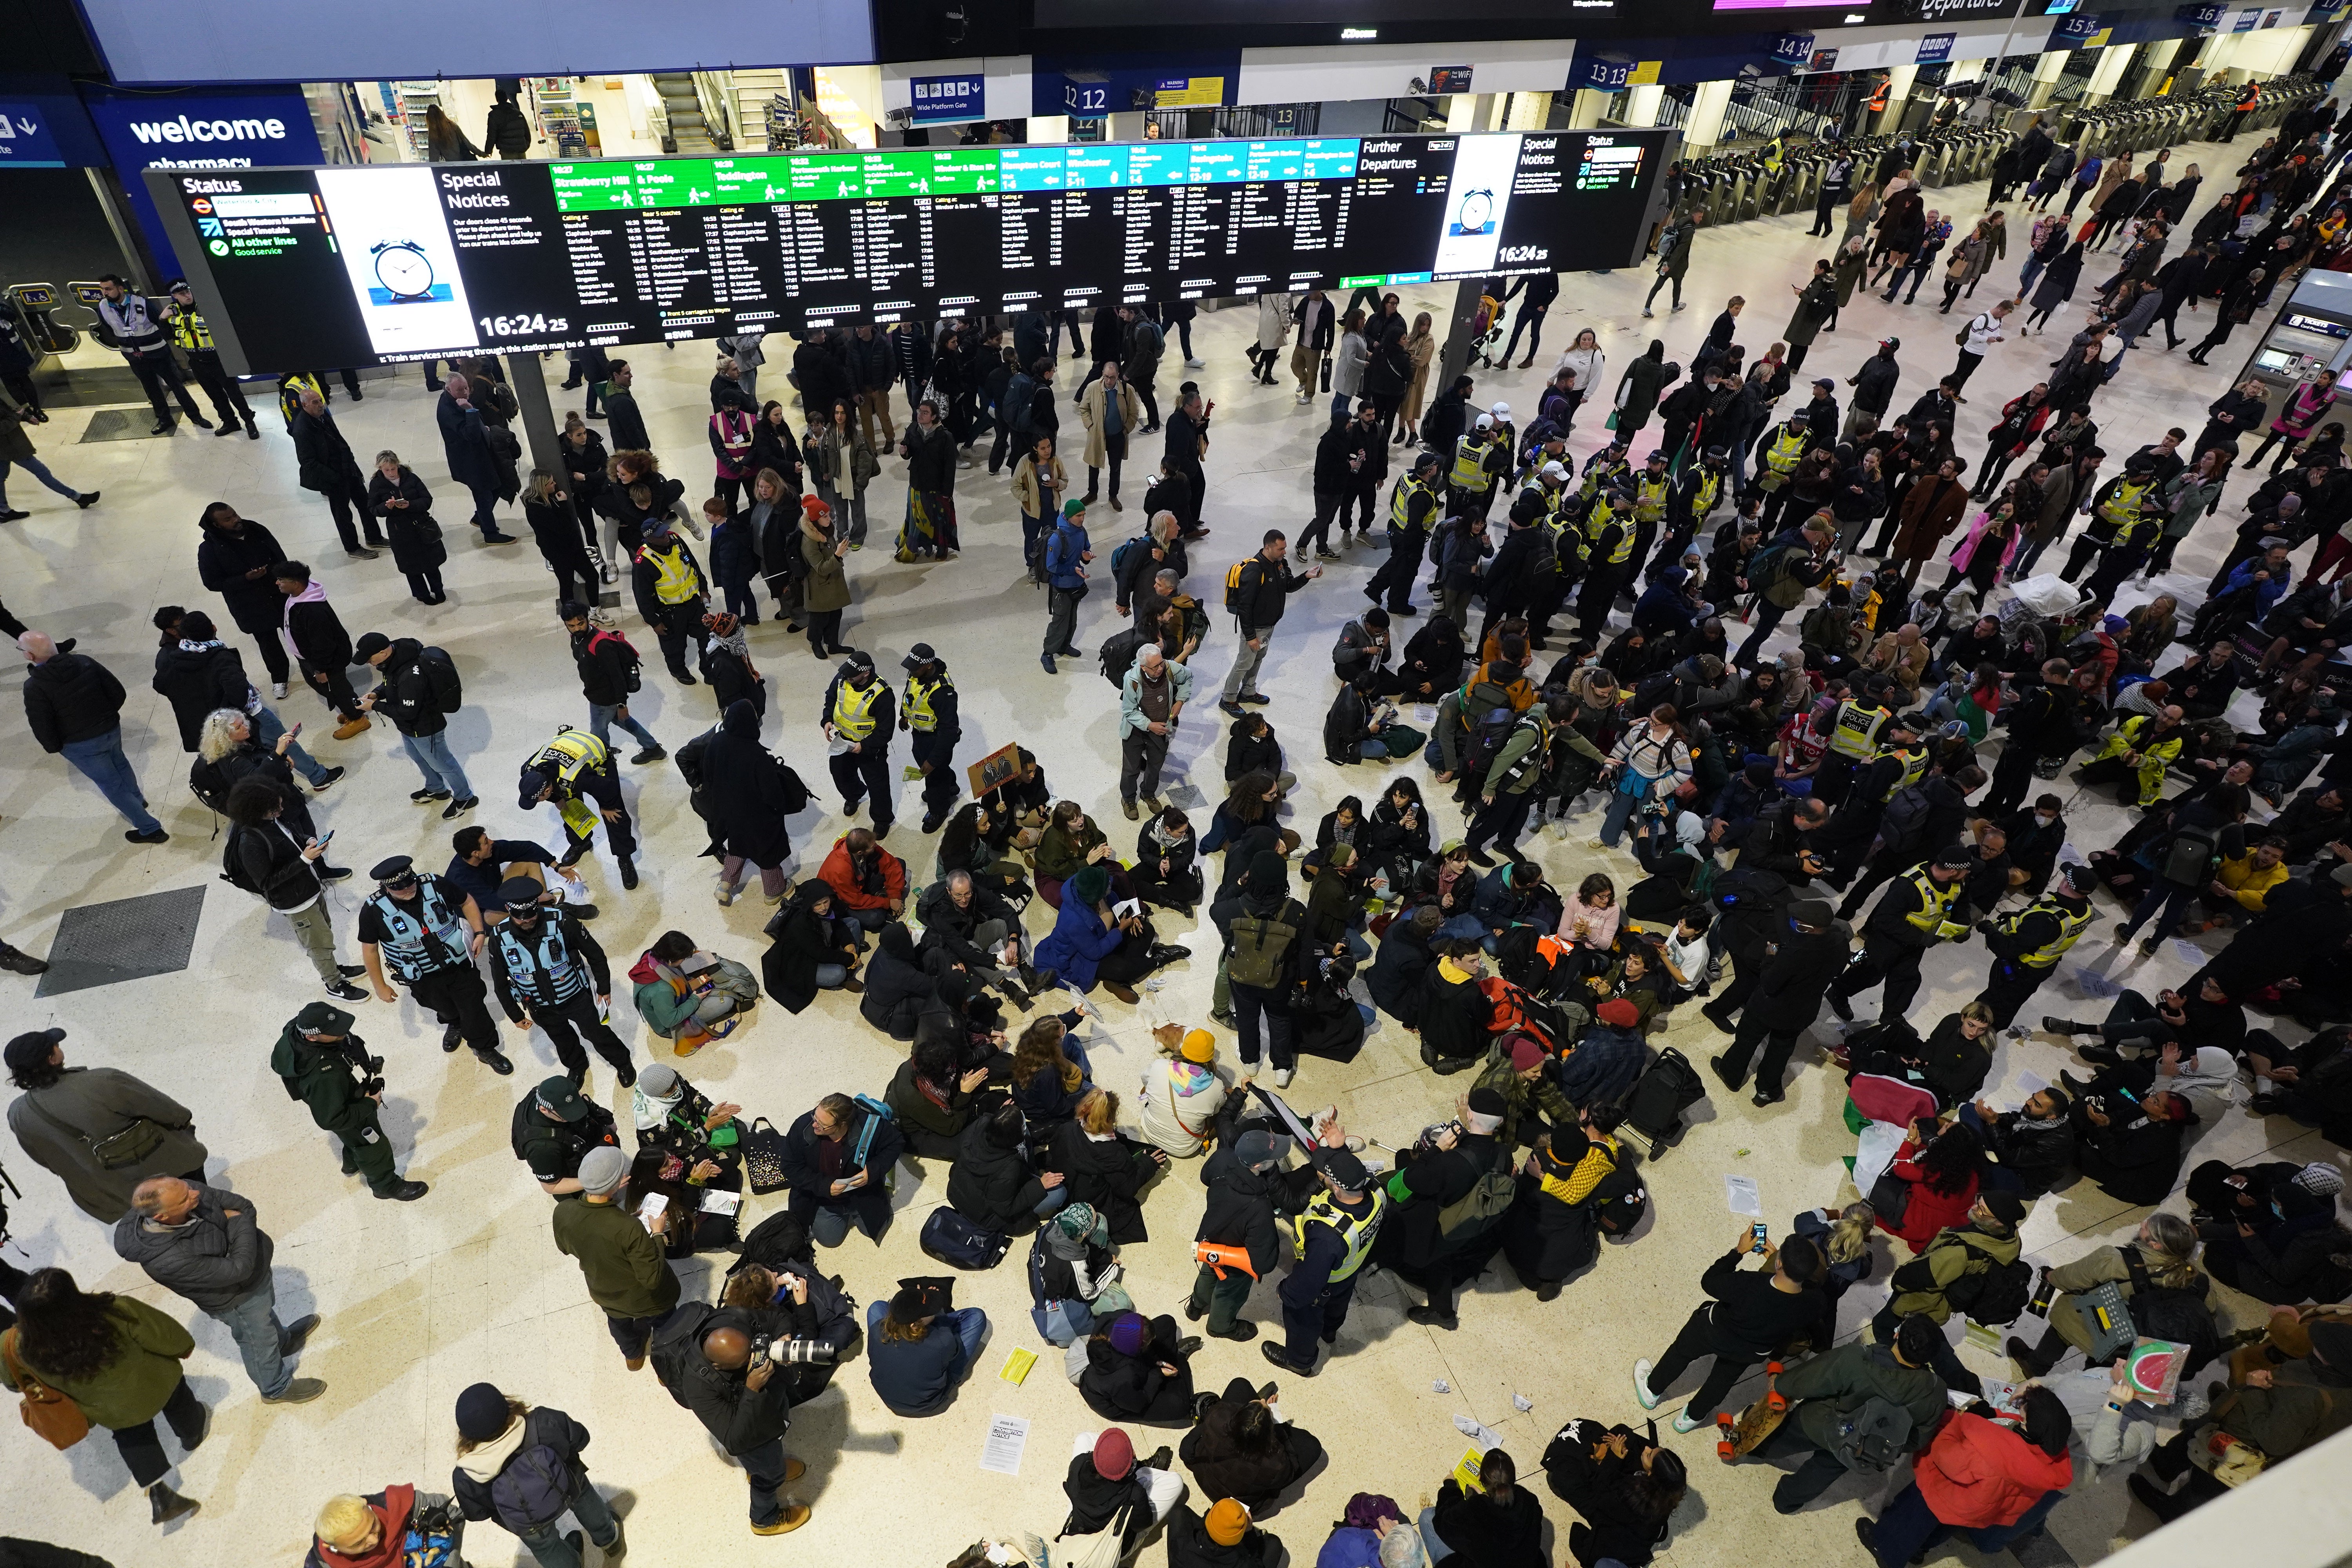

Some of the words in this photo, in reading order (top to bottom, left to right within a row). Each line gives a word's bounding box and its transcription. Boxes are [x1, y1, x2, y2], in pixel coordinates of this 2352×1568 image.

[2197, 8, 2215, 21] 16
[2065, 18, 2085, 32] 15
[2084, 21, 2096, 33] 15
[1777, 38, 1795, 55] 14
[1797, 42, 1811, 56] 14
[1590, 64, 1607, 82] 13
[1610, 68, 1626, 84] 13
[1065, 85, 1076, 108] 12
[1083, 89, 1105, 109] 12
[1278, 109, 1293, 123] 13
[130, 115, 285, 143] welcome
[1363, 141, 1402, 153] Further
[1523, 138, 1557, 152] Special
[1587, 136, 1614, 146] Status
[1360, 159, 1417, 172] Departures
[1521, 154, 1555, 165] Notices
[552, 165, 573, 174] 16:27
[441, 171, 501, 191] Special
[555, 177, 610, 188] Strawberry
[612, 176, 630, 185] Hill
[637, 175, 646, 184] &
[646, 174, 674, 183] Poole
[715, 171, 767, 182] Teddington
[183, 178, 242, 194] Status
[447, 193, 510, 208] Notices
[559, 199, 568, 209] 5
[641, 196, 655, 205] 12
[281, 217, 316, 226] Mainline
[227, 228, 253, 237] Special
[254, 227, 290, 235] Timetable
[232, 239, 245, 247] All
[246, 238, 272, 247] other
[274, 236, 298, 245] lines
[1499, 246, 1536, 262] 16:24
[1535, 249, 1548, 260] 25
[814, 319, 834, 327] SWR
[882, 314, 900, 322] SWR
[2304, 318, 2328, 328] TICKETS
[480, 314, 547, 336] 16:24
[549, 318, 568, 332] 25
[745, 324, 765, 333] SWR
[597, 336, 619, 345] SWR
[672, 330, 693, 339] SWR
[409, 352, 441, 361] services
[442, 349, 473, 359] running
[474, 346, 506, 357] through
[506, 345, 521, 354] this
[521, 343, 548, 352] station
[549, 342, 565, 351] may
[1460, 451, 1479, 462] POLICE
[909, 652, 920, 662] POLICE
[1844, 712, 1871, 727] POLICE
[1846, 722, 1861, 731] OSU
[548, 749, 574, 765] POLICE
[558, 746, 579, 758] SERIAL
[976, 759, 985, 768] EVIL
[987, 744, 1011, 762] PERSONIFIED
[977, 785, 995, 797] BROTHERS
[1002, 770, 1019, 783] GENOCIDE
[443, 927, 453, 936] POLICE
[555, 964, 567, 972] POLICE
[1360, 1224, 1370, 1238] BRITISH
[1370, 1207, 1383, 1227] TRANSPORT
[1361, 1211, 1383, 1244] POLICE
[994, 1426, 1023, 1436] PROHIBITION
[1464, 1463, 1479, 1477] NOTICE
